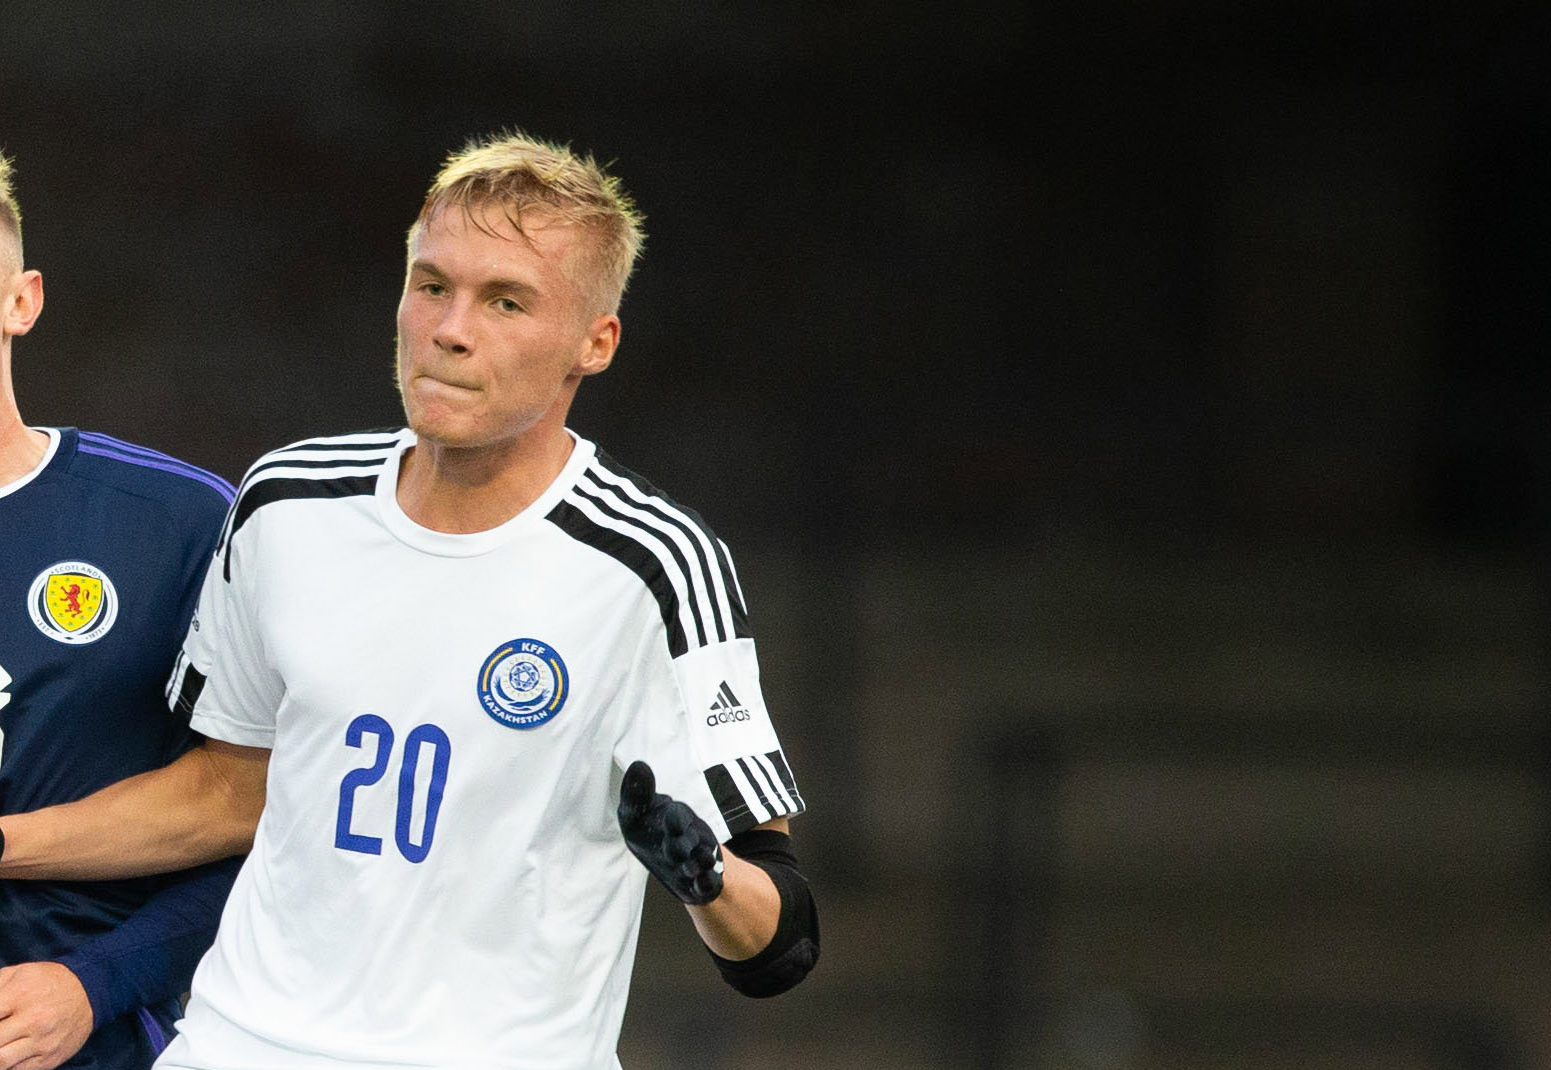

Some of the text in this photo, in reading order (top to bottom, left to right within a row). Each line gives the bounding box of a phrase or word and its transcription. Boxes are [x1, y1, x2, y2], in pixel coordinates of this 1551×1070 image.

[53, 564, 98, 577] SCOTLAND
[521, 642, 546, 655] KFF
[482, 694, 548, 724] KAZAKHSTAN
[706, 707, 750, 727] adidas
[335, 714, 451, 863] 20
